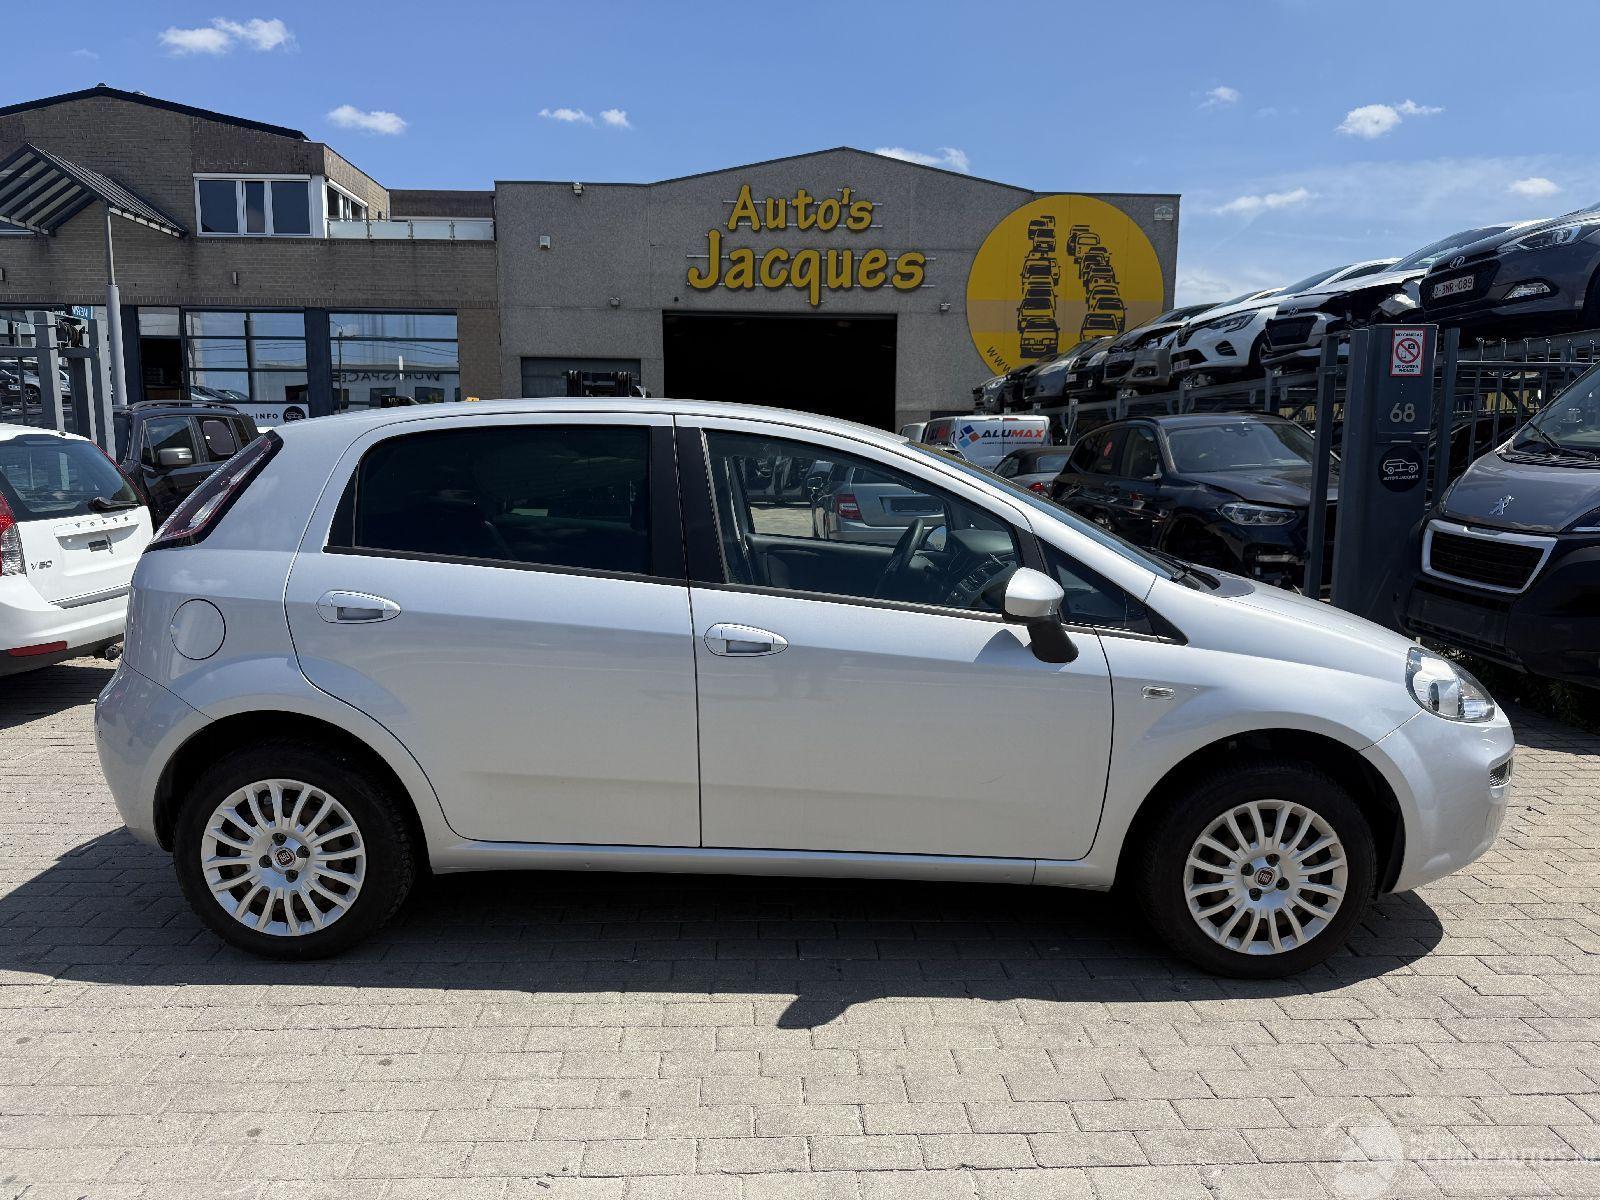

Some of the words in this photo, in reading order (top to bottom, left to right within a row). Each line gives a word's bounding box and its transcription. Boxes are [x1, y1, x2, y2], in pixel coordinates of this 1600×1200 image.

[727, 184, 874, 232] Auto's
[686, 229, 926, 306] Jacques
[1390, 402, 1416, 423] 68
[981, 429, 1045, 439] ALUMAX
